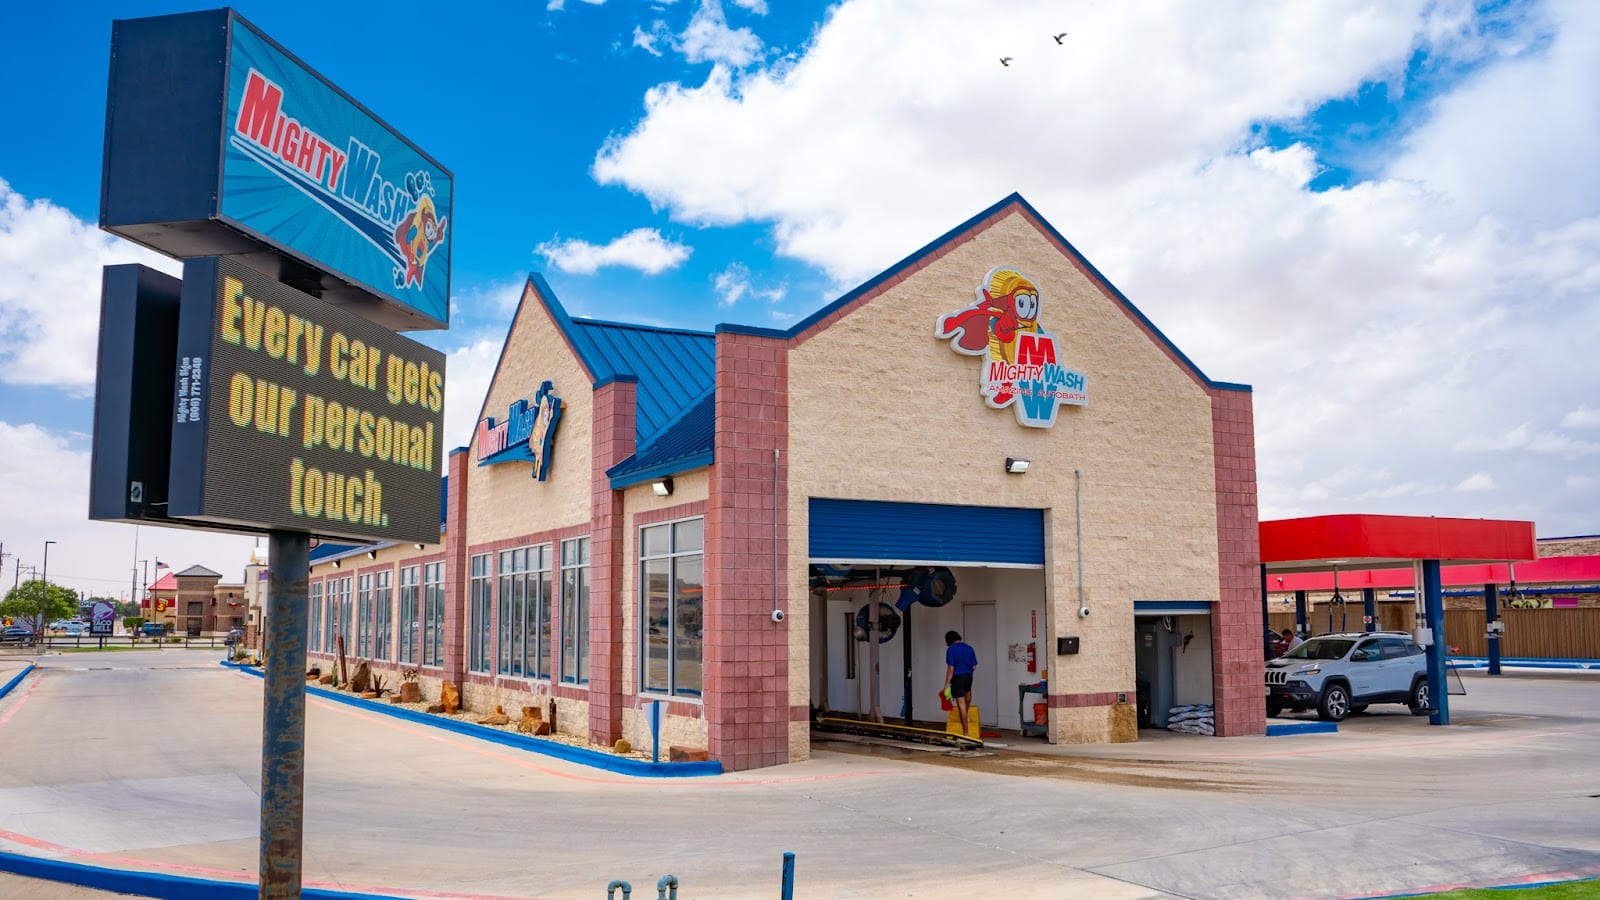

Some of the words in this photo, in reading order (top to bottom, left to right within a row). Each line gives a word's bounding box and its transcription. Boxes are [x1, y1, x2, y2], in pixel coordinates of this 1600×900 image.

[236, 70, 346, 190] MIGHTY
[342, 136, 409, 226] WASH
[222, 276, 324, 376] Every
[329, 331, 381, 391] car
[386, 352, 443, 414] gets
[989, 361, 1044, 382] MIGHTY
[1044, 363, 1084, 391] WASH
[989, 385, 1034, 397] AMAZING
[1037, 389, 1087, 401] AUTOBATH
[302, 393, 435, 472] personal
[289, 457, 390, 527] touch.
